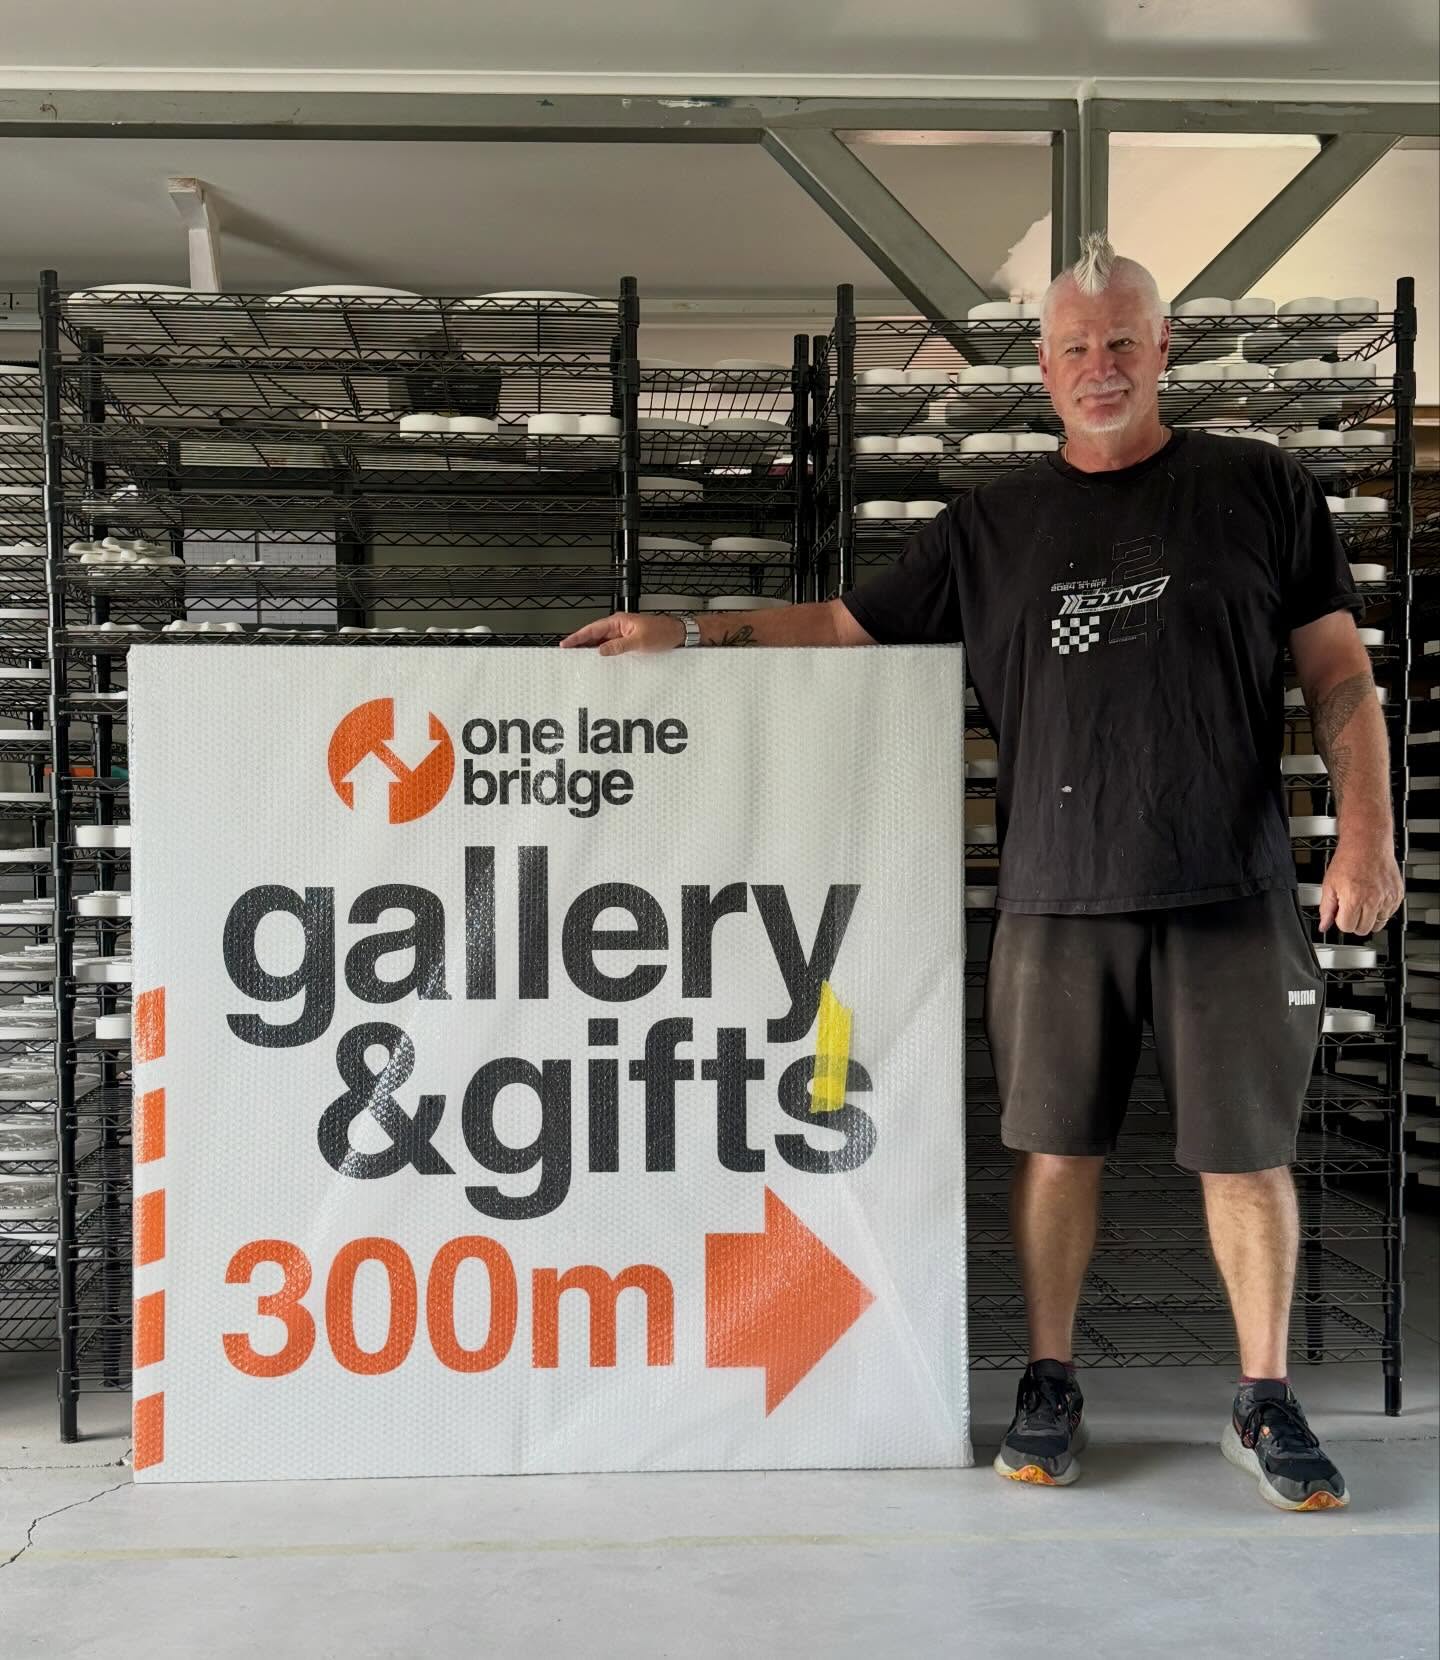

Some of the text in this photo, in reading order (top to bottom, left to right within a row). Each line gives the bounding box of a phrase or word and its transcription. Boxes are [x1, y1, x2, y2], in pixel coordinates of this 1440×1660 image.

[462, 706, 689, 756] one lane
[463, 757, 634, 818] bridge
[222, 845, 861, 1049] gallery
[1287, 989, 1317, 1006] PUMA
[221, 1236, 674, 1378] 300m
